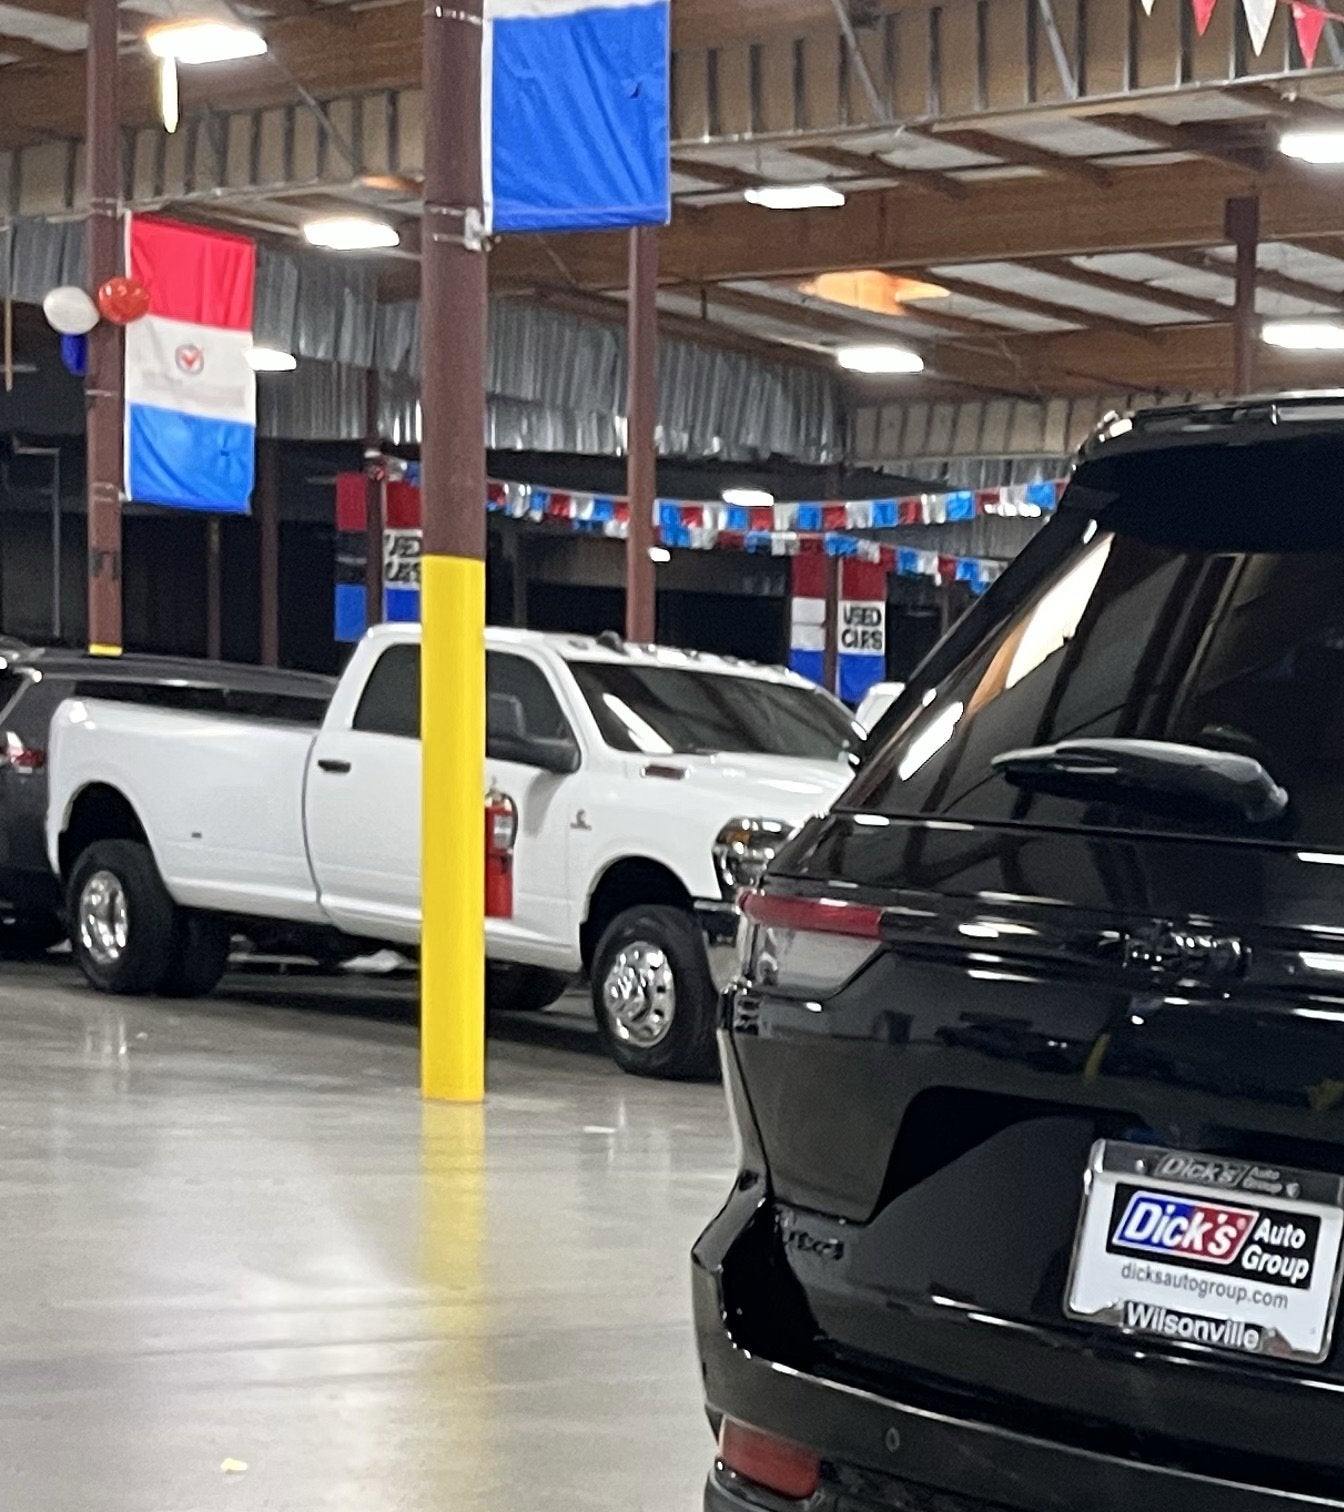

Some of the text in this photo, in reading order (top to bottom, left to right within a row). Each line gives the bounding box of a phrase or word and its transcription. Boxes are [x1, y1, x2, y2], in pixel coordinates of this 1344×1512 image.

[1124, 1201, 1238, 1256] Dick's
[1253, 1218, 1306, 1249] Auto
[1121, 1262, 1288, 1309] dicksautogroup.com
[1241, 1244, 1309, 1284] Group
[1126, 1301, 1260, 1350] Wilsonville
